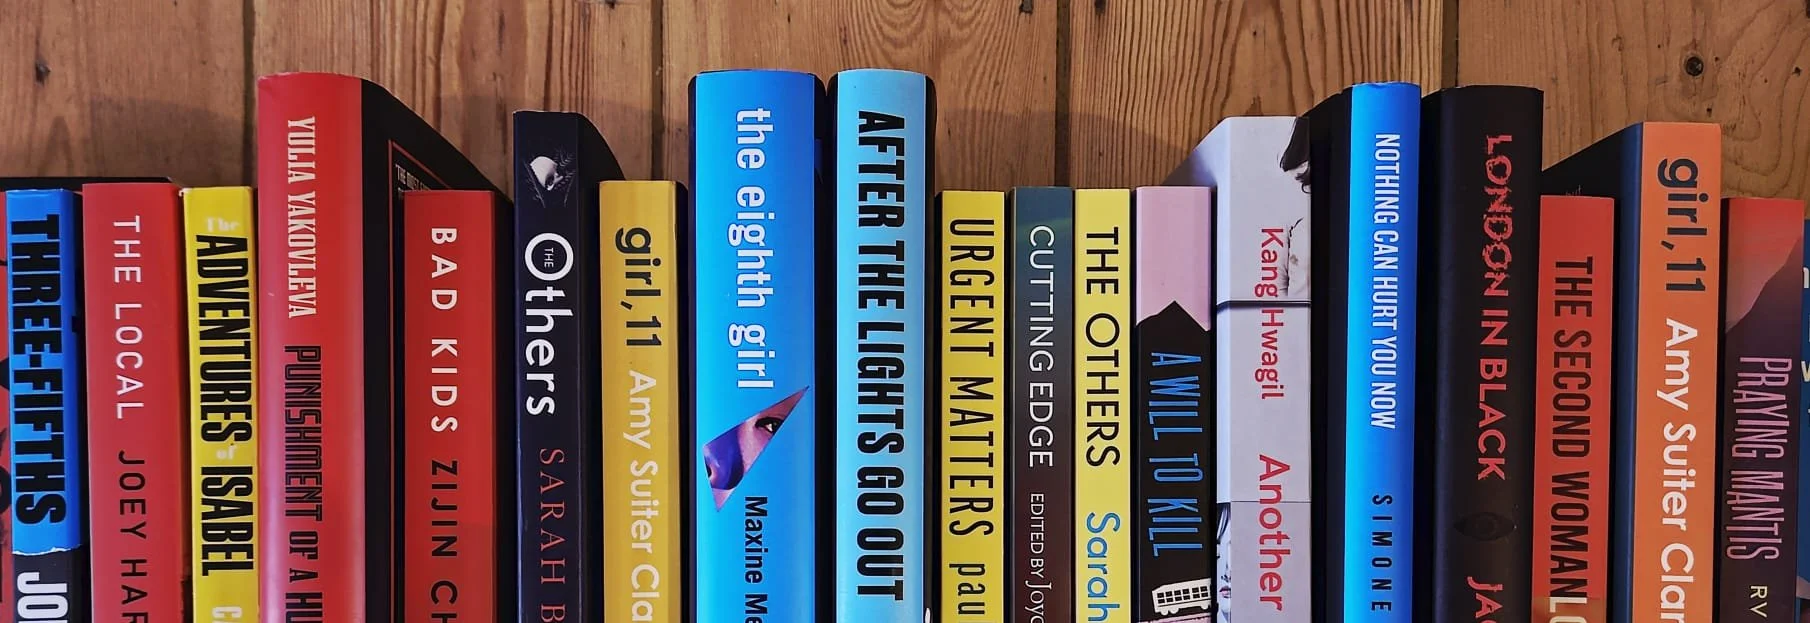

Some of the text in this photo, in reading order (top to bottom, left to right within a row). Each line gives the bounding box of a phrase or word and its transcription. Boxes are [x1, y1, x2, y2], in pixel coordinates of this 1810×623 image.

[287, 116, 317, 319] YULIA YAKOVLEVA
[543, 248, 554, 268] THE
[614, 227, 662, 346] girl, 11
[727, 107, 776, 388] the eighth girl
[1370, 134, 1401, 429] NOTHING CAN HURT YOU NOW
[1657, 158, 1708, 292] girl, 11
[9, 213, 67, 525] THREE-FIFTHS
[113, 215, 144, 419] THE LOCAL
[195, 234, 253, 442] ADVENTURES
[430, 227, 458, 432] BAD KIDS
[524, 232, 574, 416] Others
[856, 110, 905, 601] AFTER THE LIGHTS GO OUT
[948, 219, 995, 536] URGENT MATTERS
[1029, 225, 1055, 468] CUTTING EDGE
[1085, 226, 1121, 467] THE OTHERS
[1252, 228, 1285, 400] Kang Hwagil
[1477, 134, 1513, 481] LONDON IN BLACK
[1656, 318, 1698, 411] Amy
[118, 450, 147, 539] JOEY
[284, 345, 323, 522] PUNISHMENT
[623, 370, 660, 622] Amy Suiter Cla
[1147, 352, 1203, 557] A WILL TO KILL
[1549, 256, 1594, 598] THE SECOND WOMAN
[1661, 422, 1697, 531] Suiter
[1726, 357, 1793, 560] PRAYING MANTIS
[201, 465, 254, 577] ISABEL
[289, 530, 319, 560] OF
[289, 568, 319, 583] A
[430, 460, 458, 557] ZIJIN
[539, 448, 566, 584] SARAH
[744, 496, 769, 584] Maxine
[1030, 493, 1045, 554] EDITED
[1030, 558, 1044, 578] BY
[1086, 512, 1121, 622] Sarah
[1258, 454, 1291, 611] Another
[1371, 494, 1393, 611] SIMONE
[211, 606, 243, 623] C
[1467, 576, 1504, 623] JA
[1748, 584, 1770, 619] RV
